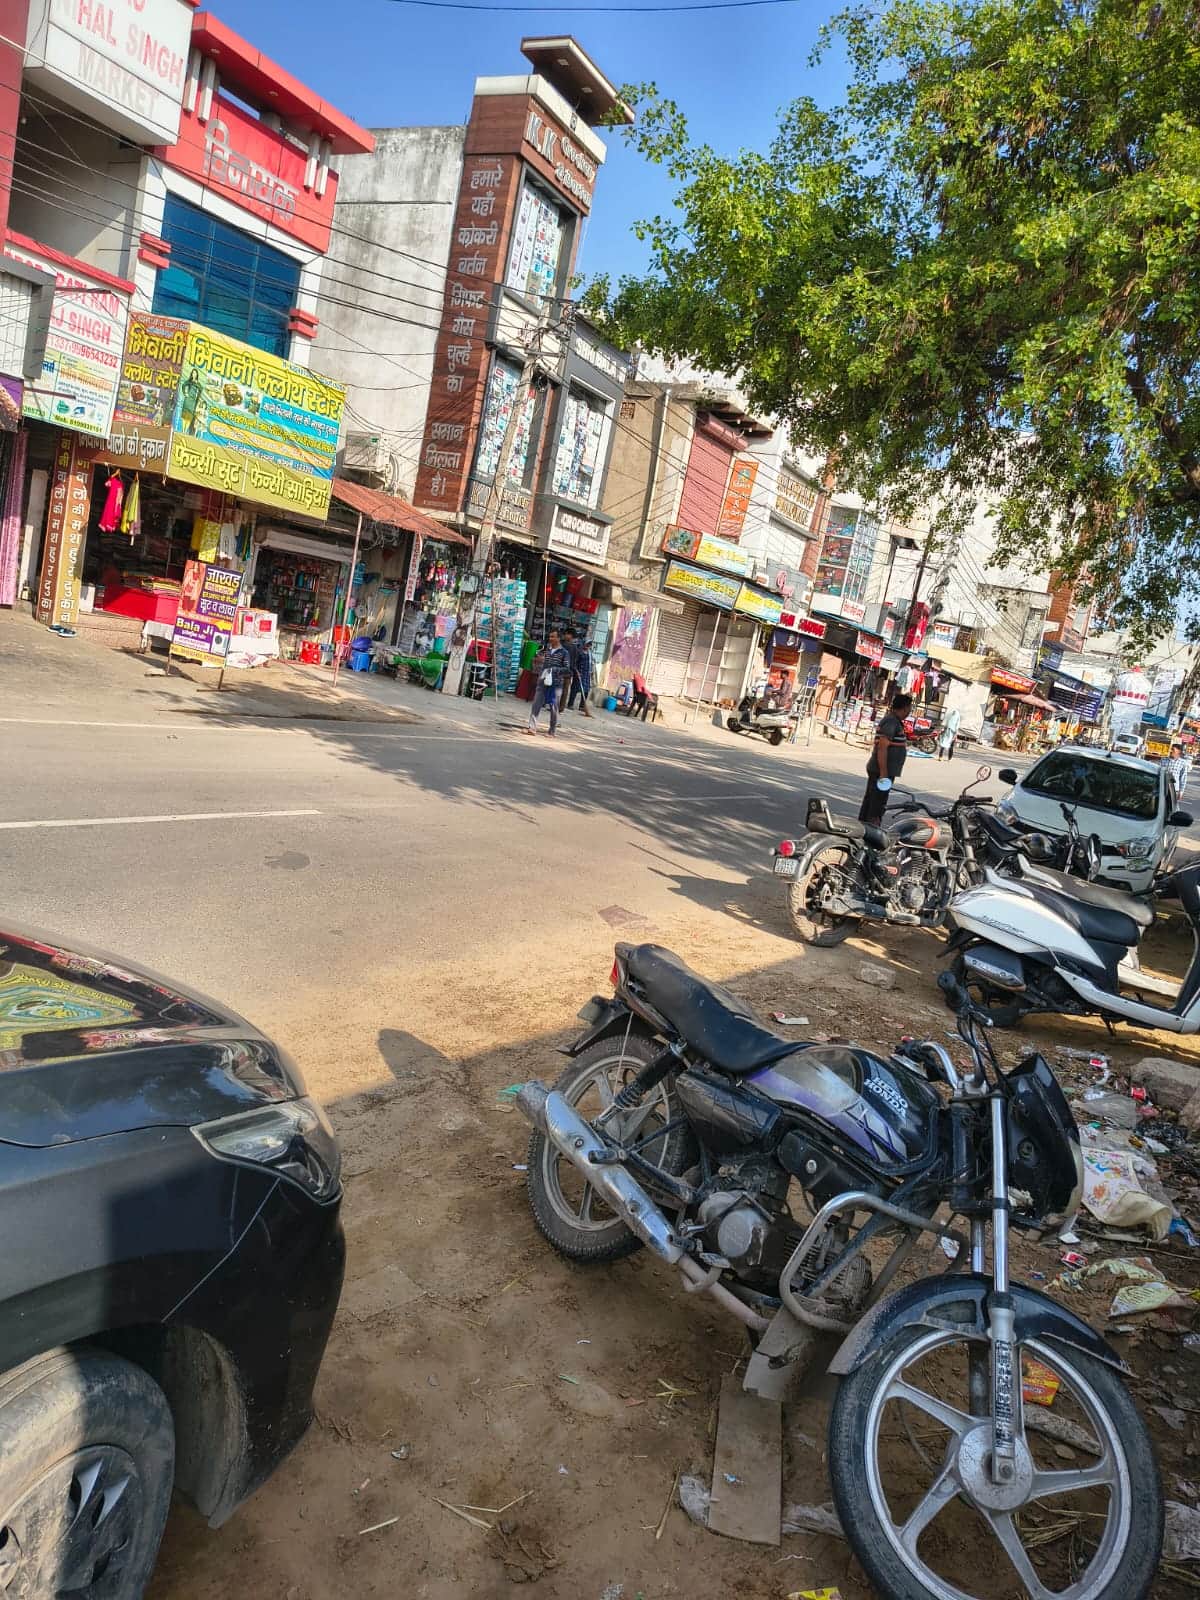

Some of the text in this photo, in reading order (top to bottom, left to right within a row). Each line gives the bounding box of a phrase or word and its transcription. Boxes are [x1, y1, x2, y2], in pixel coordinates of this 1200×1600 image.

[126, 23, 184, 88] SINGH
[79, 43, 159, 120] MARKET
[470, 164, 504, 189] हमारे
[458, 250, 488, 276] बर्तन
[69, 311, 112, 345] SINGH
[127, 322, 187, 366] भिवानी
[188, 331, 256, 388] भिवानी
[446, 374, 464, 393] का
[140, 434, 166, 469] दुकान
[424, 442, 462, 469] मिलता
[217, 457, 242, 491] सूट
[176, 617, 200, 633] Bala
[863, 1079, 906, 1118] HONDA
[872, 1077, 908, 1108] HERO
